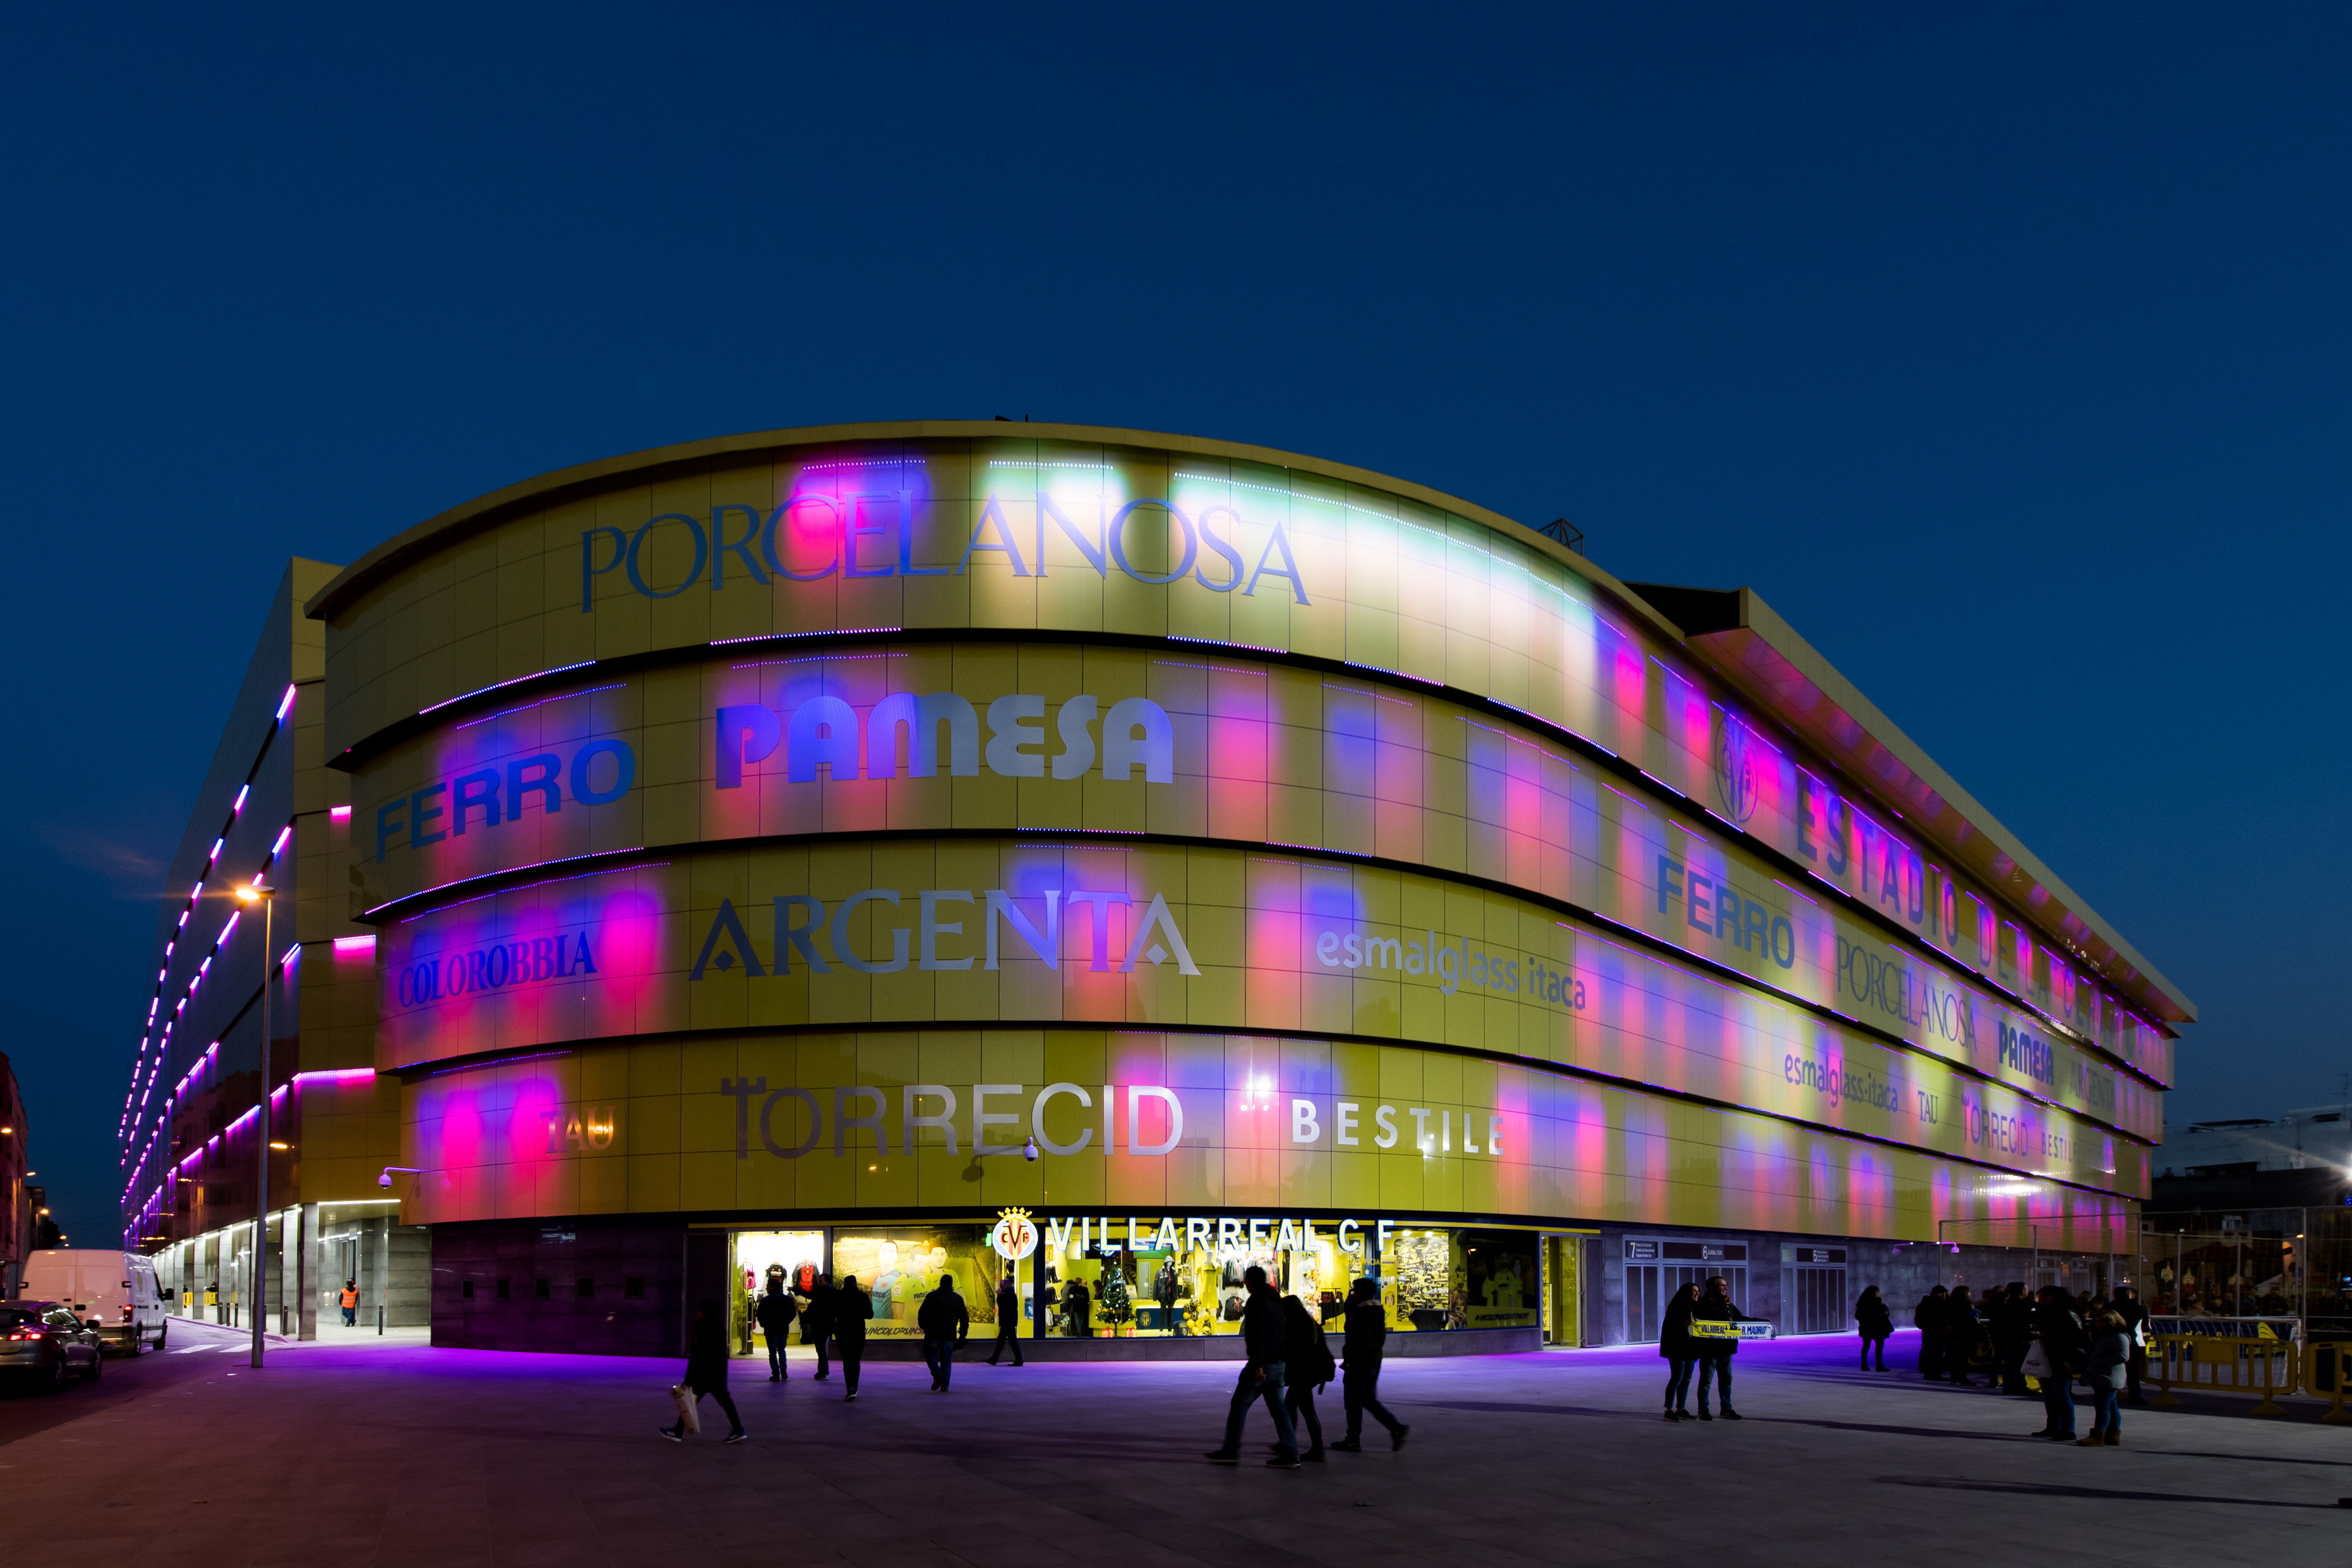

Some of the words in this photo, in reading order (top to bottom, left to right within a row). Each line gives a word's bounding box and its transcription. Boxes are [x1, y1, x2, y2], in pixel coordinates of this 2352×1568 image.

[581, 489, 1312, 614] PORCELANOSA
[716, 691, 1173, 790] PAMESA
[376, 739, 635, 864] FERRO
[1657, 854, 1796, 969] FERRO
[1796, 782, 1959, 948] ESTADIO
[1979, 905, 2009, 981] DE
[2024, 936, 2049, 1006] LA
[687, 889, 1202, 981] ARGENTA
[399, 931, 597, 1008] COLOROBBIA
[1837, 935, 1978, 1053] PORCELANOSA
[1998, 1020, 2055, 1087] PAMESA
[539, 1106, 618, 1154] TAU
[721, 1076, 1184, 1160] TORRECID
[1292, 1099, 1504, 1156] BESTILE
[1917, 1090, 1939, 1125] TAU
[1960, 1094, 2029, 1158] TORRECID
[1049, 1216, 1322, 1252] VILLARREAL
[1630, 1242, 1636, 1259] 7
[1703, 1245, 1708, 1260] 6
[1813, 1250, 1818, 1262] 5
[872, 1290, 886, 1299] AMESA
